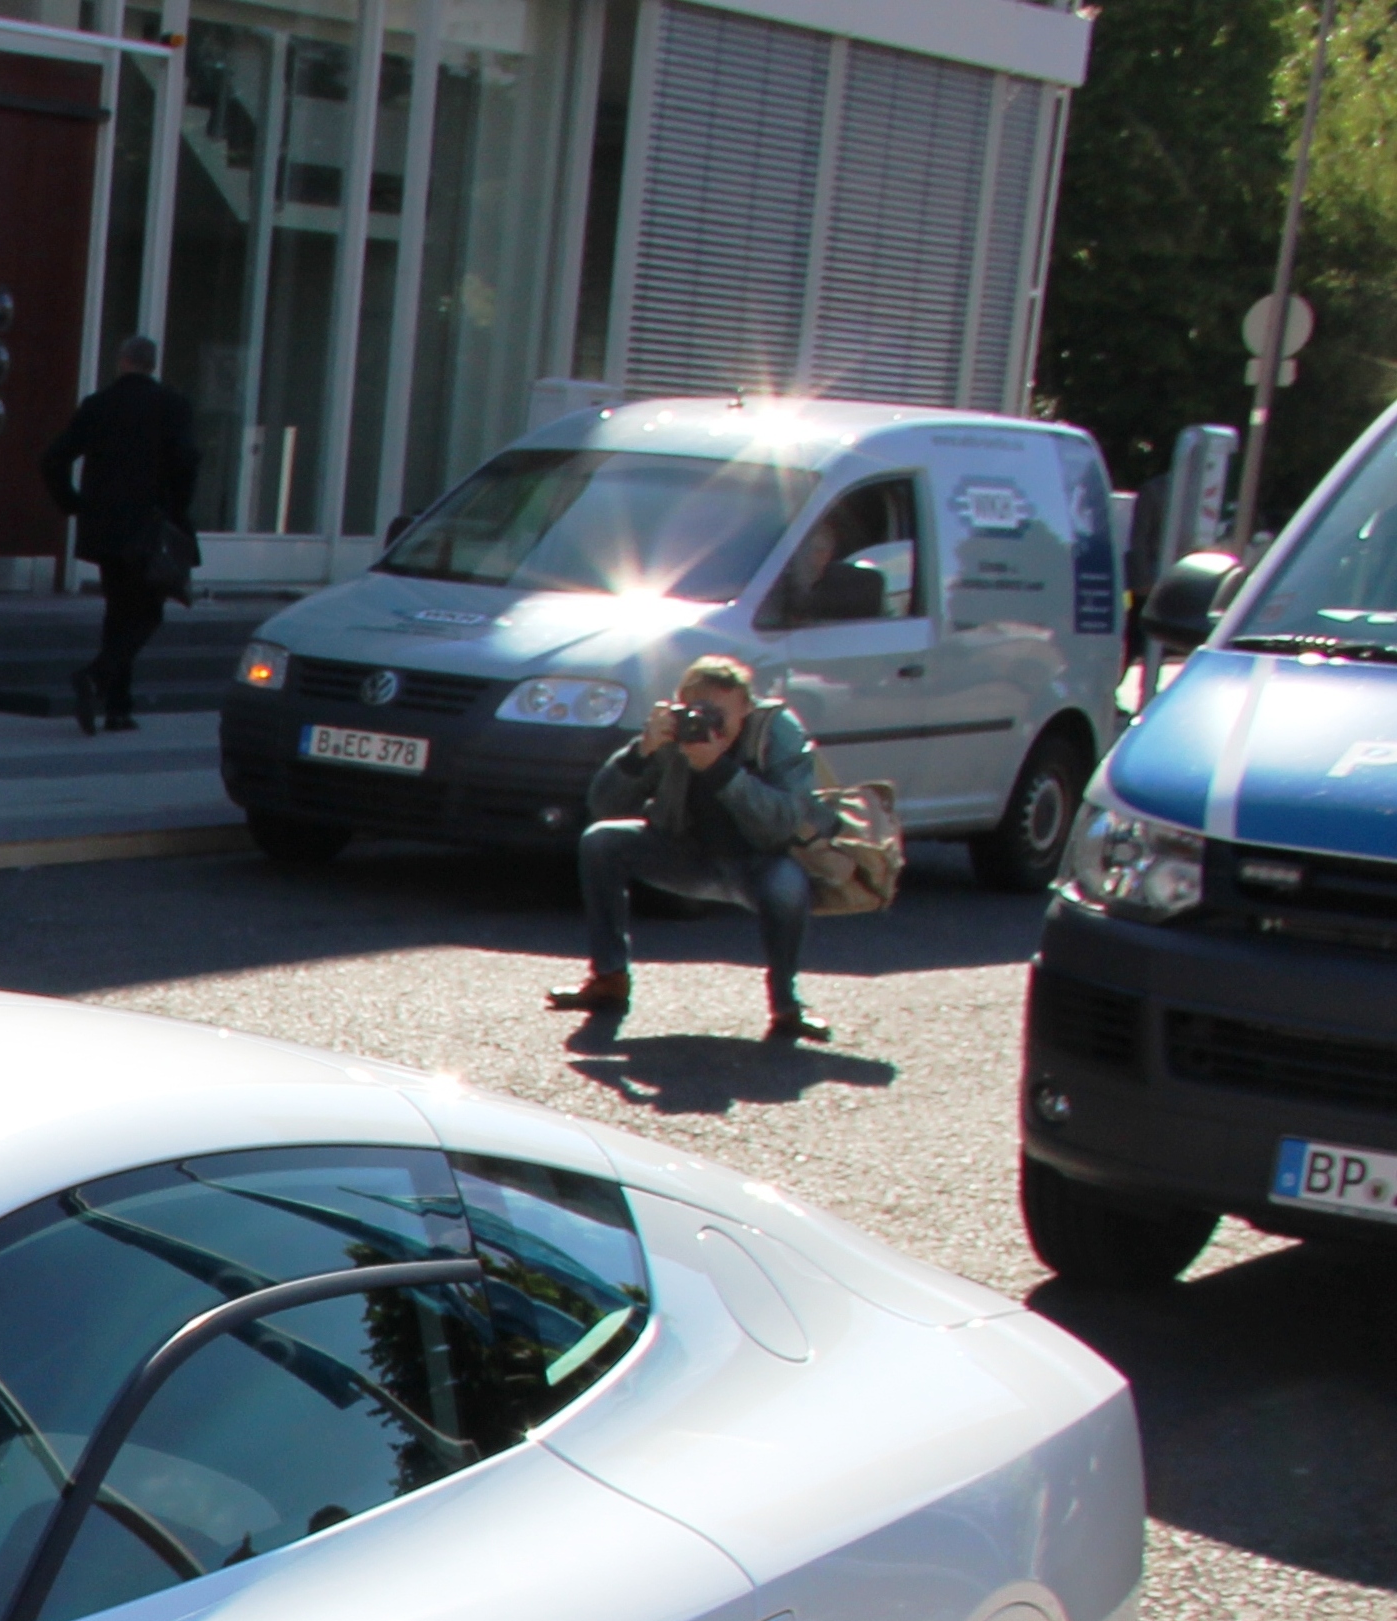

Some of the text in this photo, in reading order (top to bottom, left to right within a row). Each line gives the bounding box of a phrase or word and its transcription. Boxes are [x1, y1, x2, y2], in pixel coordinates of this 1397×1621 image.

[316, 729, 418, 765] B EC 378
[1305, 1151, 1368, 1199] BP
